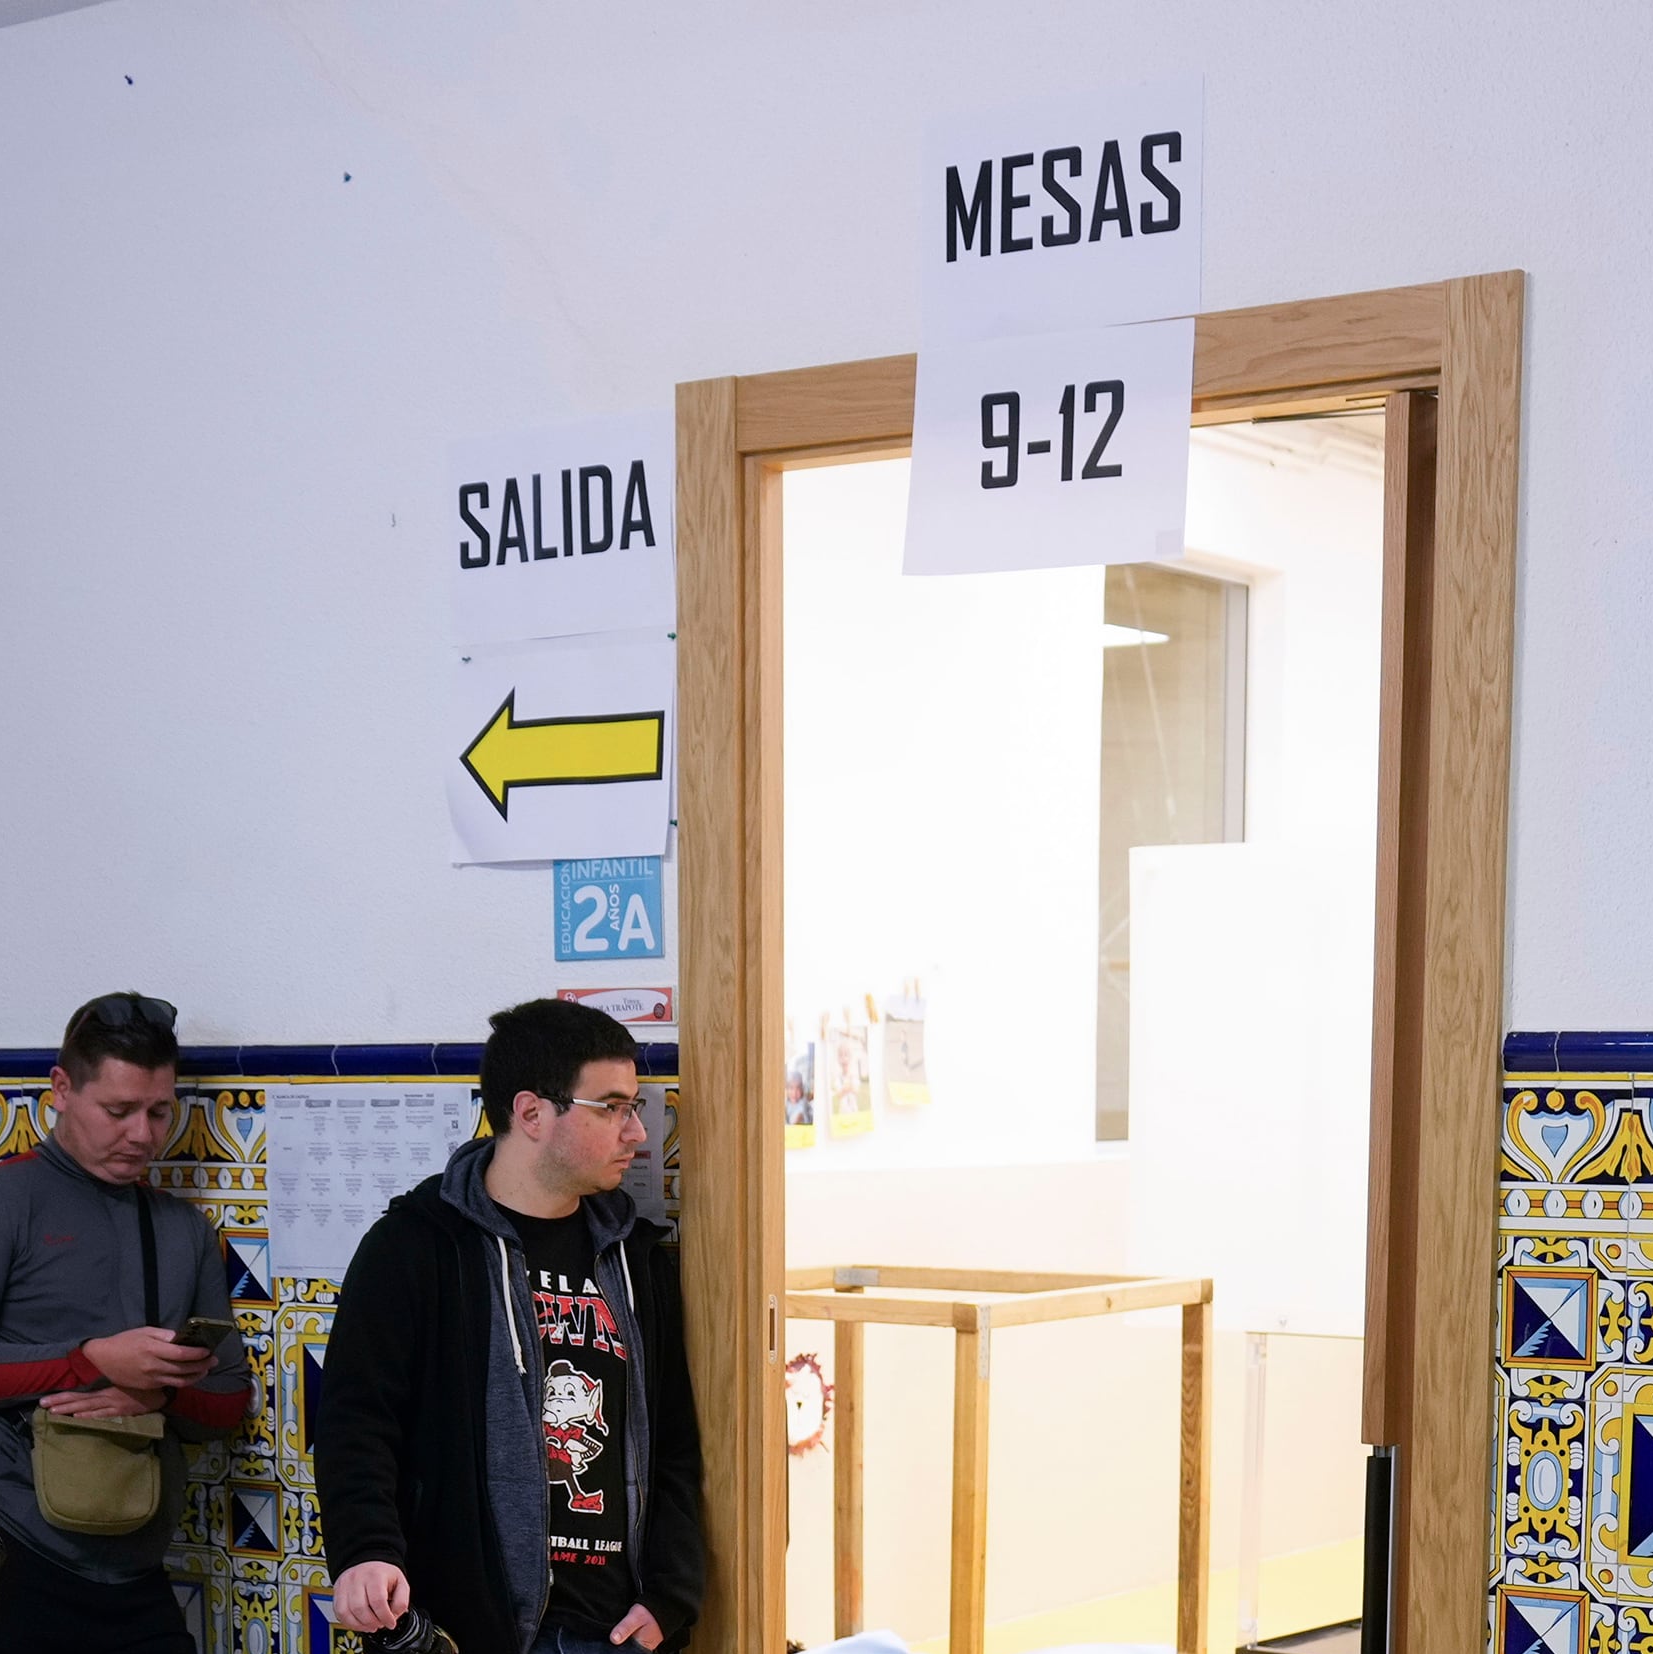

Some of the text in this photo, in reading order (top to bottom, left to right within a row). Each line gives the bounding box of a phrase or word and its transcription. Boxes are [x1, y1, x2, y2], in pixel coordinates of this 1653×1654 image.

[946, 131, 1181, 263] MESAS
[981, 379, 1124, 489] 9-12
[459, 460, 656, 569] SALIDA
[571, 858, 654, 880] INFANTIL
[608, 884, 620, 931] AÑOS
[573, 885, 655, 952] 2 A
